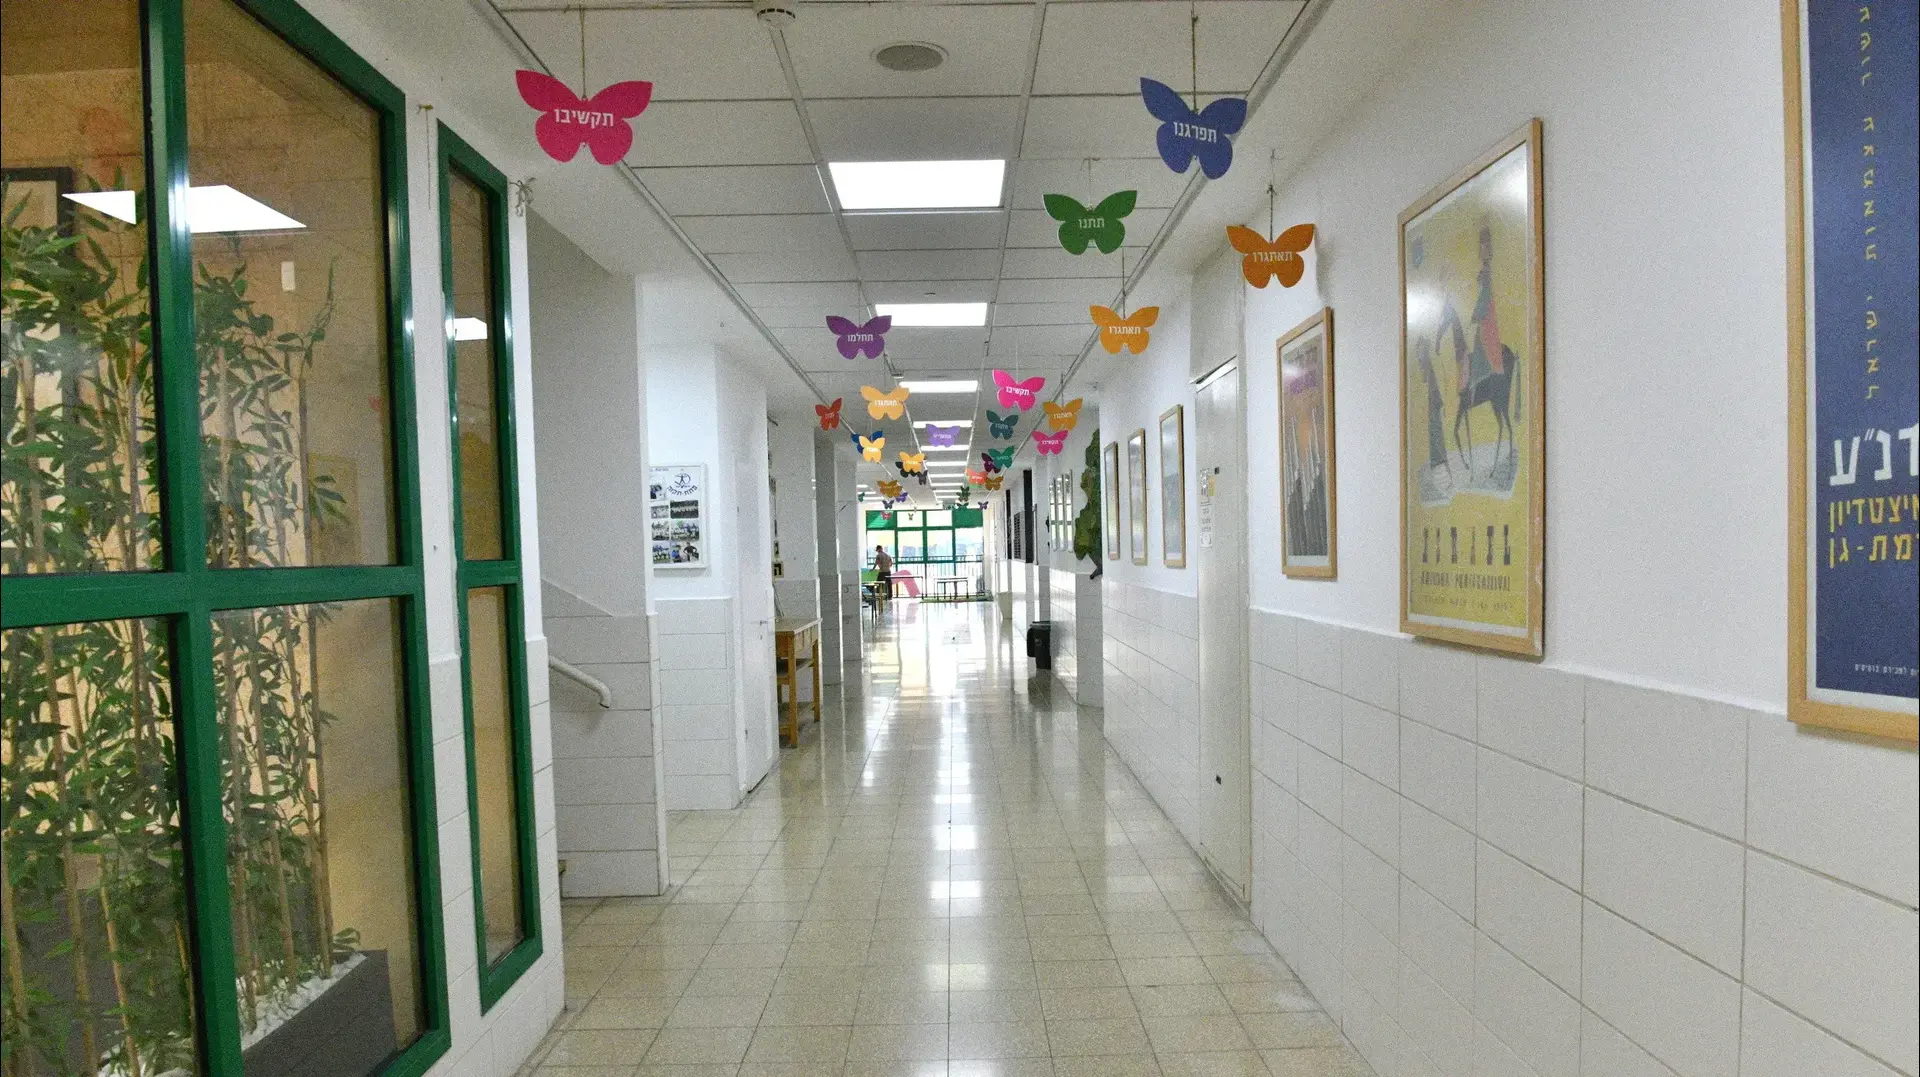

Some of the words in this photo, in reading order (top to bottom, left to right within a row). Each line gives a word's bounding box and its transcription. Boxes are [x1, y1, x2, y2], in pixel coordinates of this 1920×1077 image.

[554, 108, 614, 129] תקשיבו
[1173, 121, 1217, 143] תפרגנו
[1078, 217, 1105, 229] תתנו
[1252, 250, 1293, 263] תאתגרו
[1109, 325, 1141, 335] תאתגרו
[847, 333, 874, 342] תחלמו
[1006, 386, 1030, 396] תקשיבו
[1829, 534, 1919, 569] מת-גן
